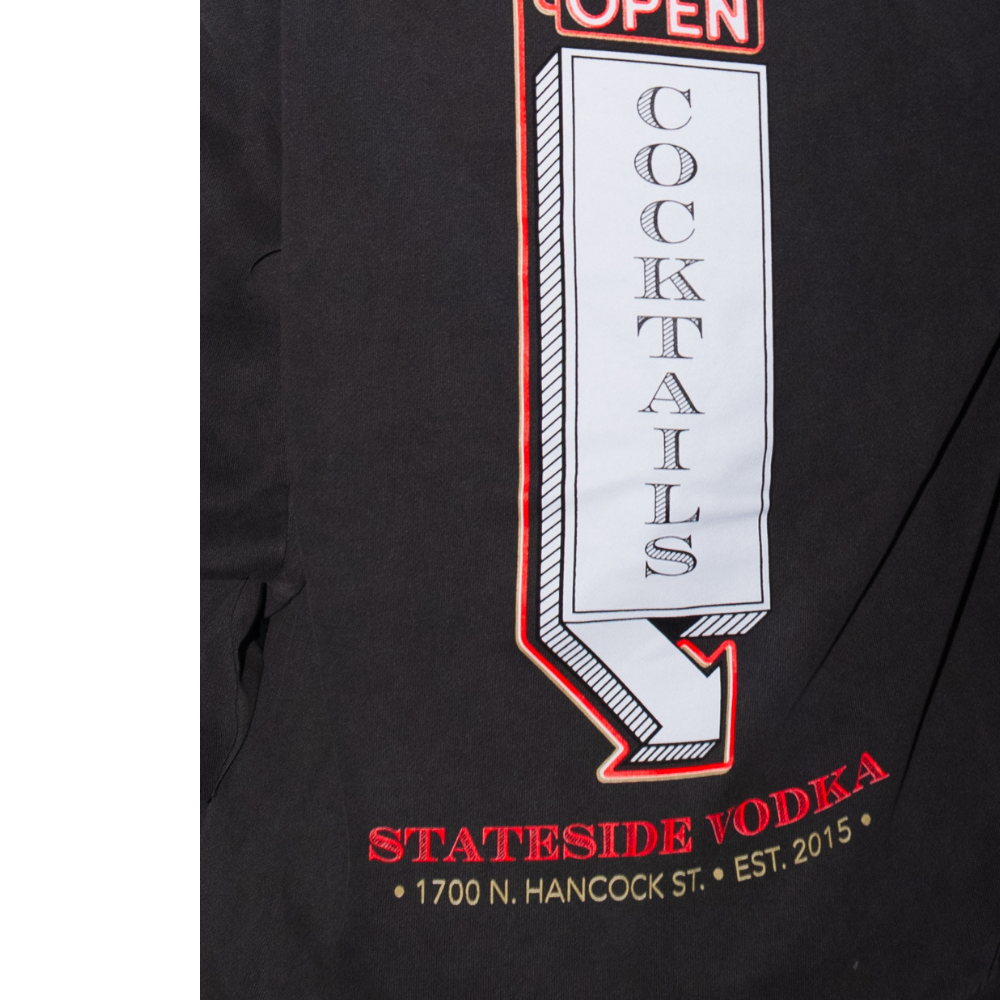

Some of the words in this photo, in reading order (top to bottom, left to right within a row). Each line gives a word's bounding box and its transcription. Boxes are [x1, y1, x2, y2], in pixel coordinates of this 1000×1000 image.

[633, 85, 706, 579] COCKTAILS
[368, 816, 693, 864] STATESIDE
[704, 750, 891, 845] VODKA
[415, 878, 481, 906] 1700
[488, 878, 517, 906] N.
[525, 872, 665, 905] HANCOCK
[672, 867, 705, 899] ST.
[734, 846, 788, 883] EST.
[792, 817, 854, 867] 2015
